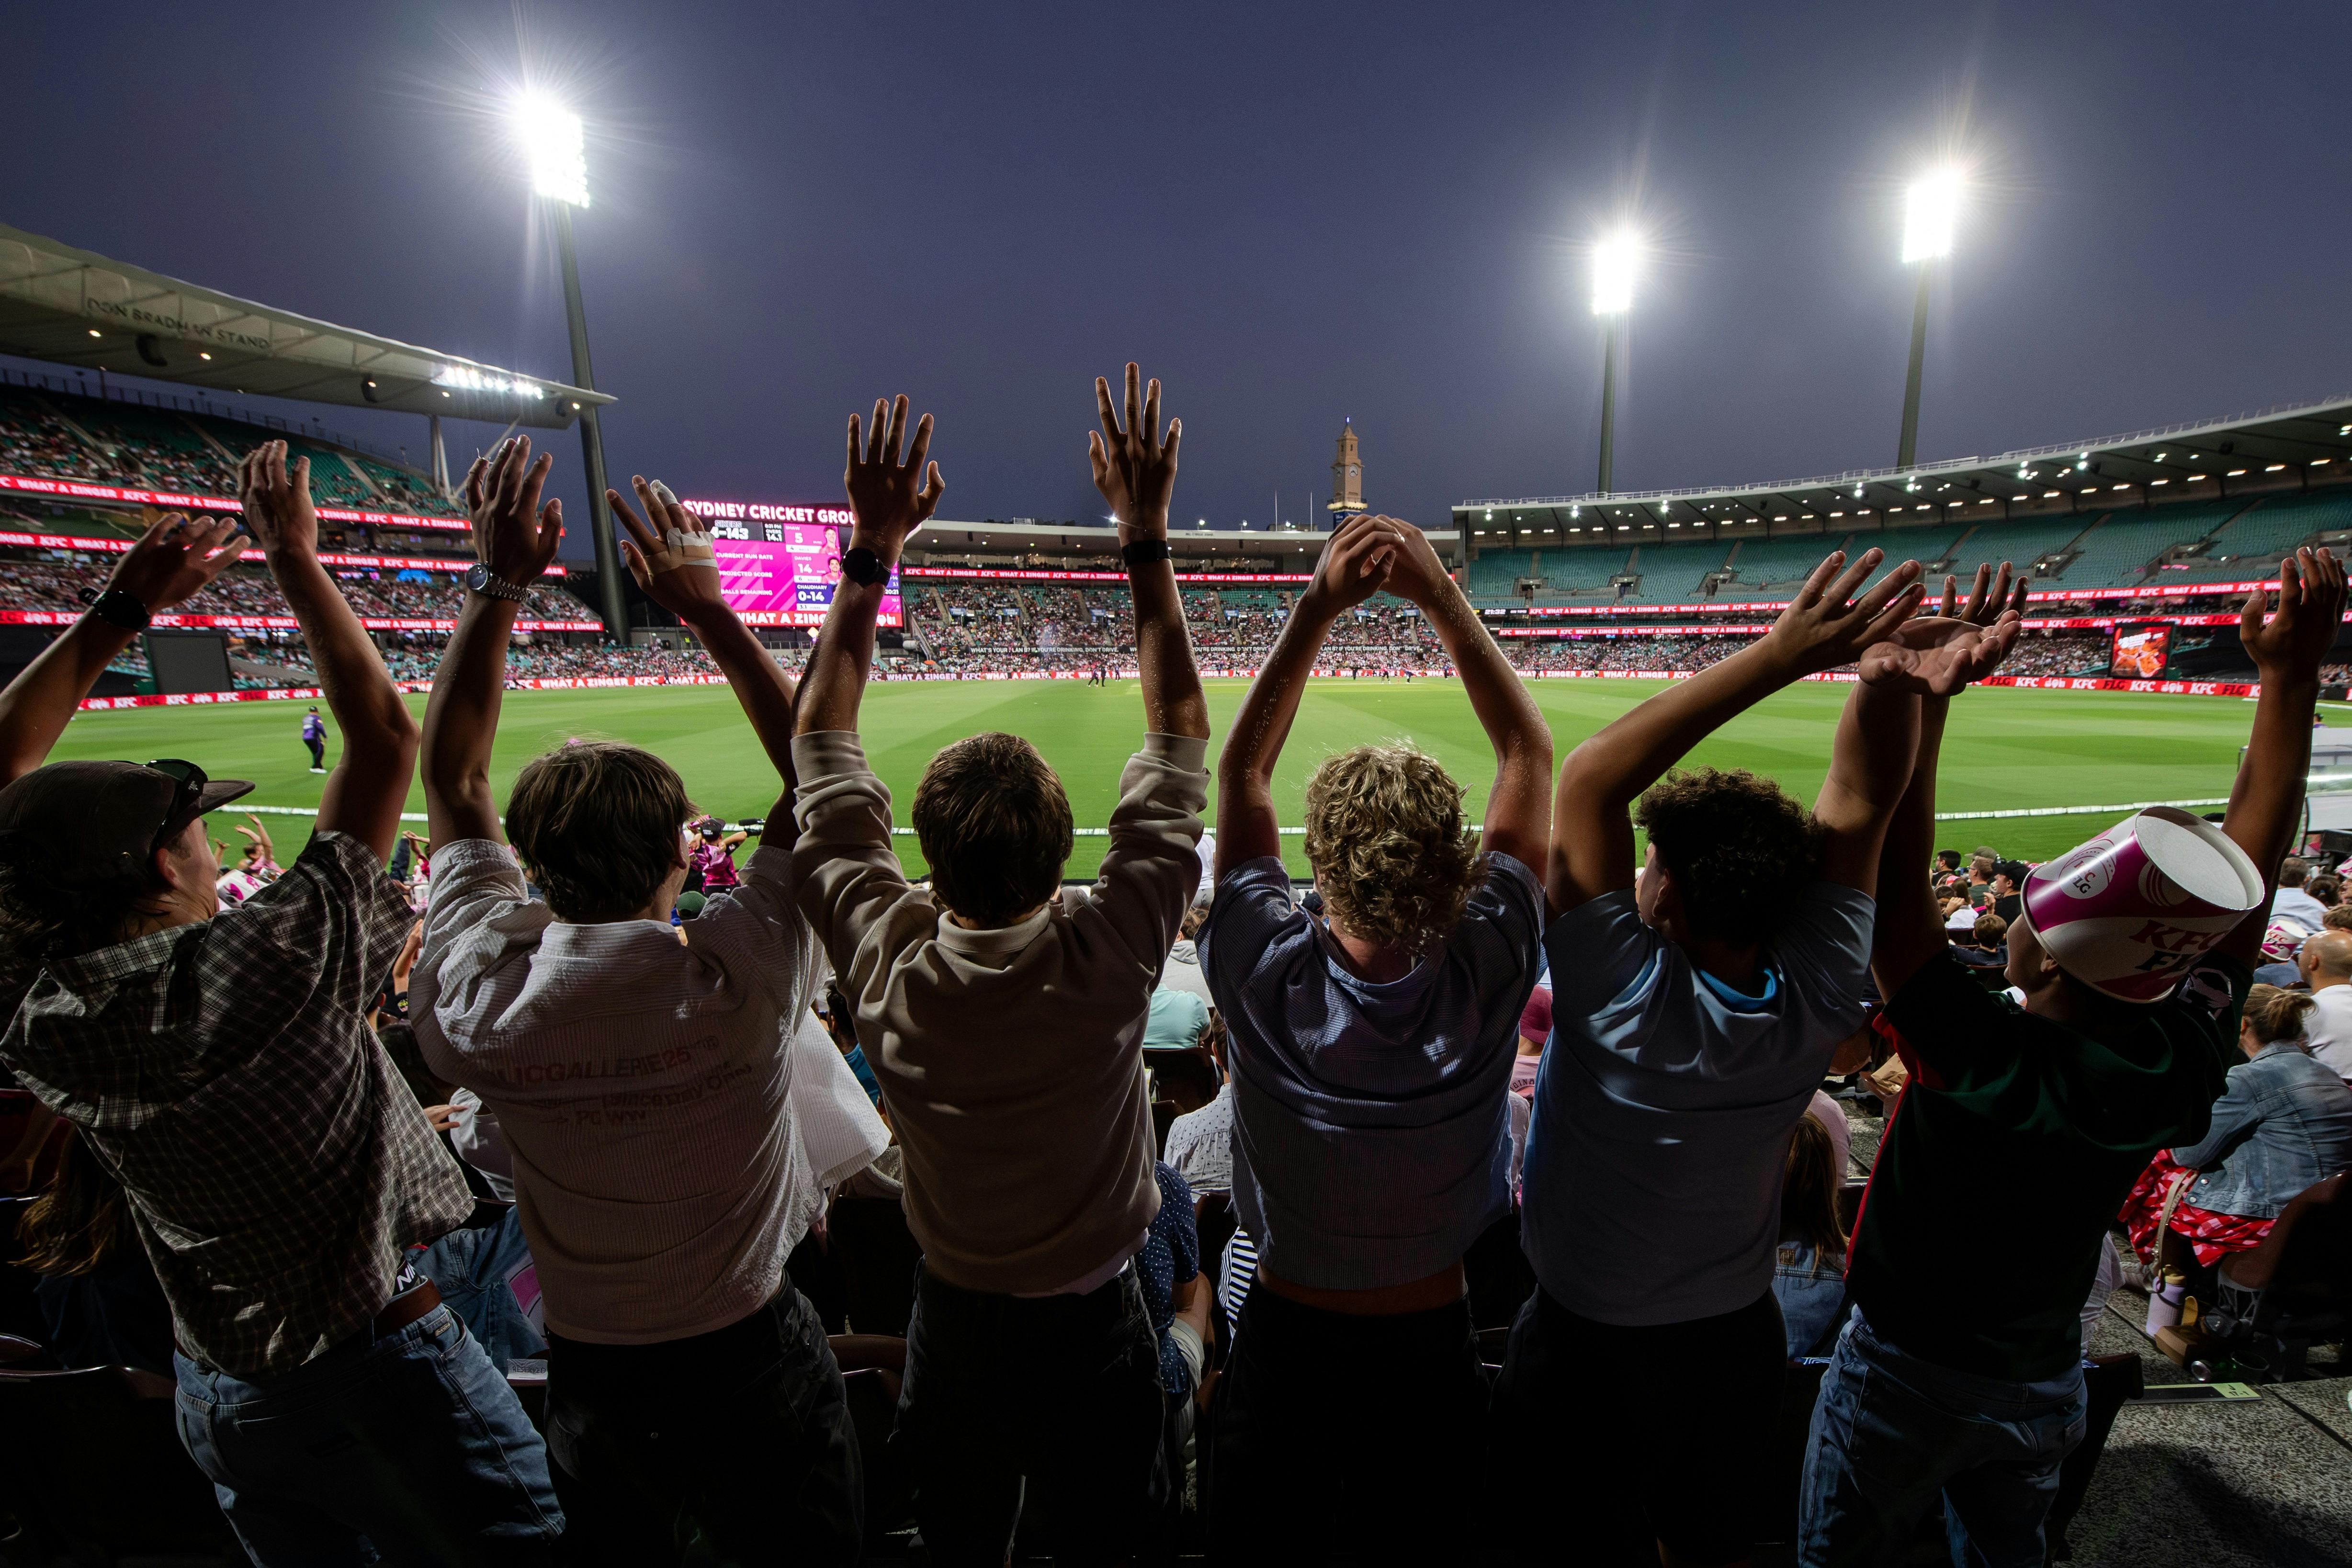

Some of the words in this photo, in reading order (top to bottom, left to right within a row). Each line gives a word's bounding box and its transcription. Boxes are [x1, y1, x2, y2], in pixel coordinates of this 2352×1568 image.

[218, 330, 270, 349] STAND
[16, 478, 56, 492] WHAT
[57, 484, 69, 493] A
[69, 485, 117, 498] ZINGER
[123, 490, 150, 503] KFC
[155, 494, 191, 506] WHAT
[192, 498, 203, 507] A
[683, 500, 746, 518] SYDNEY
[749, 505, 814, 522] CRICKET
[322, 510, 360, 521] ZINGER
[365, 513, 388, 524] KFC
[391, 516, 420, 526] WHAT
[422, 518, 430, 526] A
[430, 519, 465, 530] ZINGER
[39, 535, 68, 547] KFC
[72, 538, 107, 550] WHAT
[109, 541, 119, 551] A
[795, 532, 803, 543] 5
[337, 557, 345, 565] A
[345, 558, 380, 567] ZINGER
[384, 560, 404, 569] KFC
[407, 562, 434, 570] WHAT
[798, 564, 812, 574] 14
[798, 591, 825, 602] 0-14
[152, 616, 181, 626] KFC
[241, 618, 263, 627] KFC
[266, 619, 294, 628] WHAT
[780, 613, 791, 624] A
[2047, 620, 2068, 628] KFC
[2183, 616, 2207, 625] KFC
[366, 620, 392, 629] WHAT
[401, 621, 431, 630] ZINGER
[540, 678, 573, 688] WHAT
[576, 678, 587, 688] A
[587, 677, 628, 688] ZINGER
[634, 676, 658, 686] KFC
[698, 676, 707, 685] A
[2015, 677, 2039, 687] KFC
[2071, 679, 2097, 689] KFC
[2129, 680, 2156, 692] KFC
[2189, 682, 2217, 694] KFC
[113, 698, 137, 708] KFC
[166, 695, 189, 705] KFC
[217, 693, 239, 702] KFC
[267, 690, 289, 699] KFC
[2267, 931, 2288, 943] KFC
[512, 1365, 547, 1374] RESERVED
